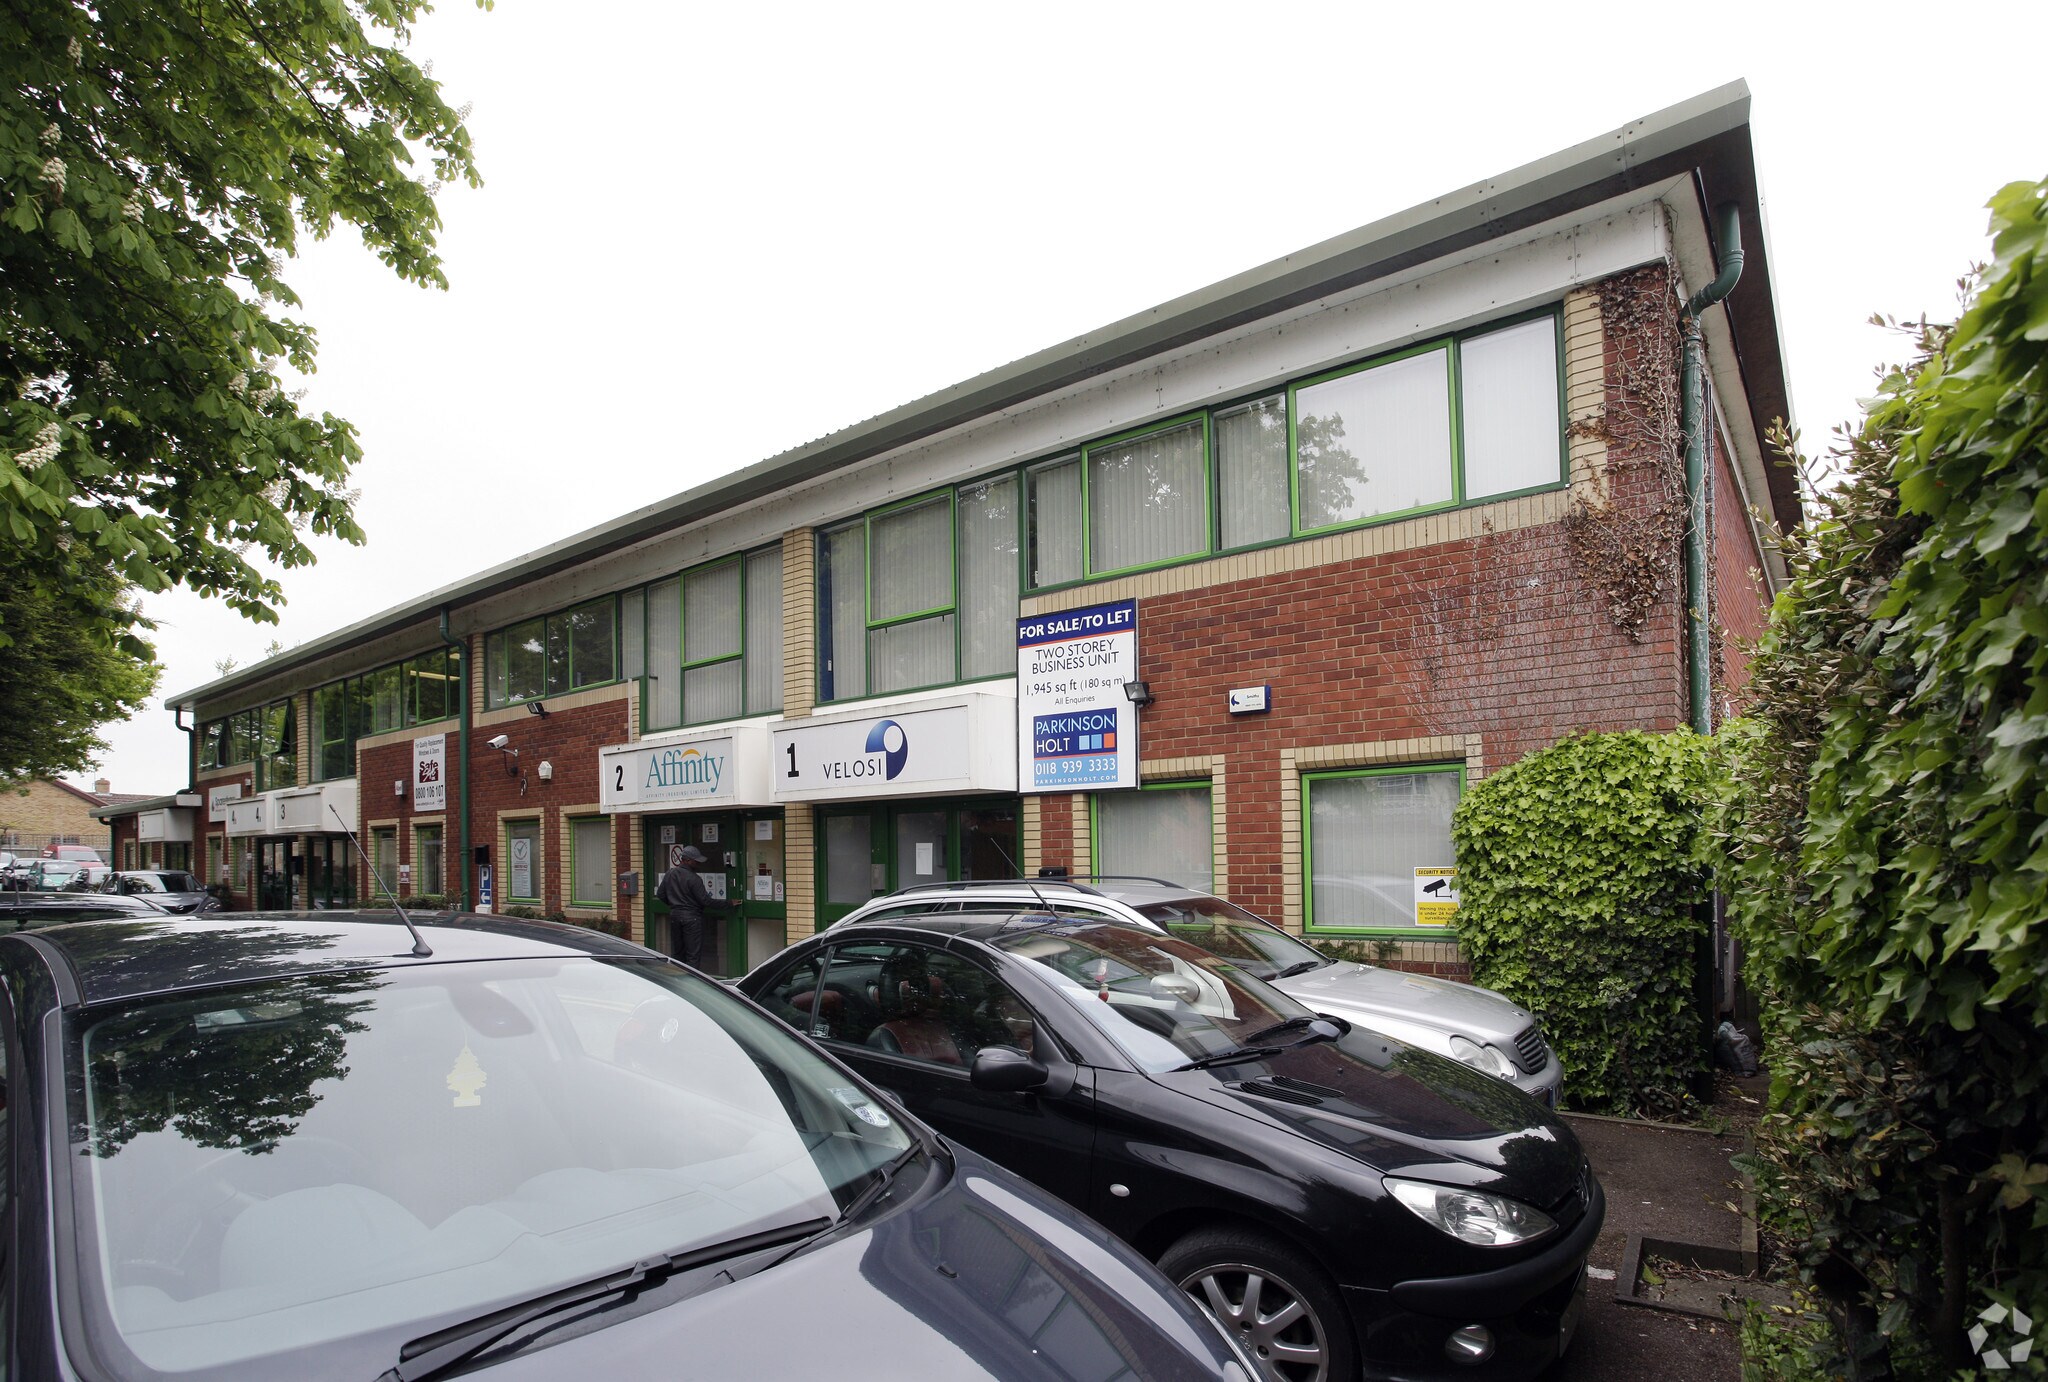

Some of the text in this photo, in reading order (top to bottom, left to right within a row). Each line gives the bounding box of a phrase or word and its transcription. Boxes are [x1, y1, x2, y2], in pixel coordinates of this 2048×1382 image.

[1020, 609, 1132, 640] FOR SALE/TO LET
[1035, 638, 1115, 661] TWO STOREY
[1032, 651, 1119, 675] BUSINESS UNIT
[1026, 675, 1126, 697] 1,945 sq ft (180 sq m)
[1054, 694, 1095, 706] All Enquiries
[1036, 713, 1115, 736] PARKINSON
[1036, 737, 1071, 754] HOLT
[419, 759, 439, 771] Safe
[645, 748, 725, 793] Affinity
[786, 742, 799, 778] 1
[823, 758, 882, 780] VELOSI
[1035, 757, 1116, 775] 0118 939 3333
[615, 764, 624, 792] 2
[1035, 774, 1117, 785] PARKINSONHOLT.COM
[415, 787, 426, 800] 0800
[435, 784, 444, 798] 107
[280, 803, 286, 820] 3
[481, 866, 489, 888] P
